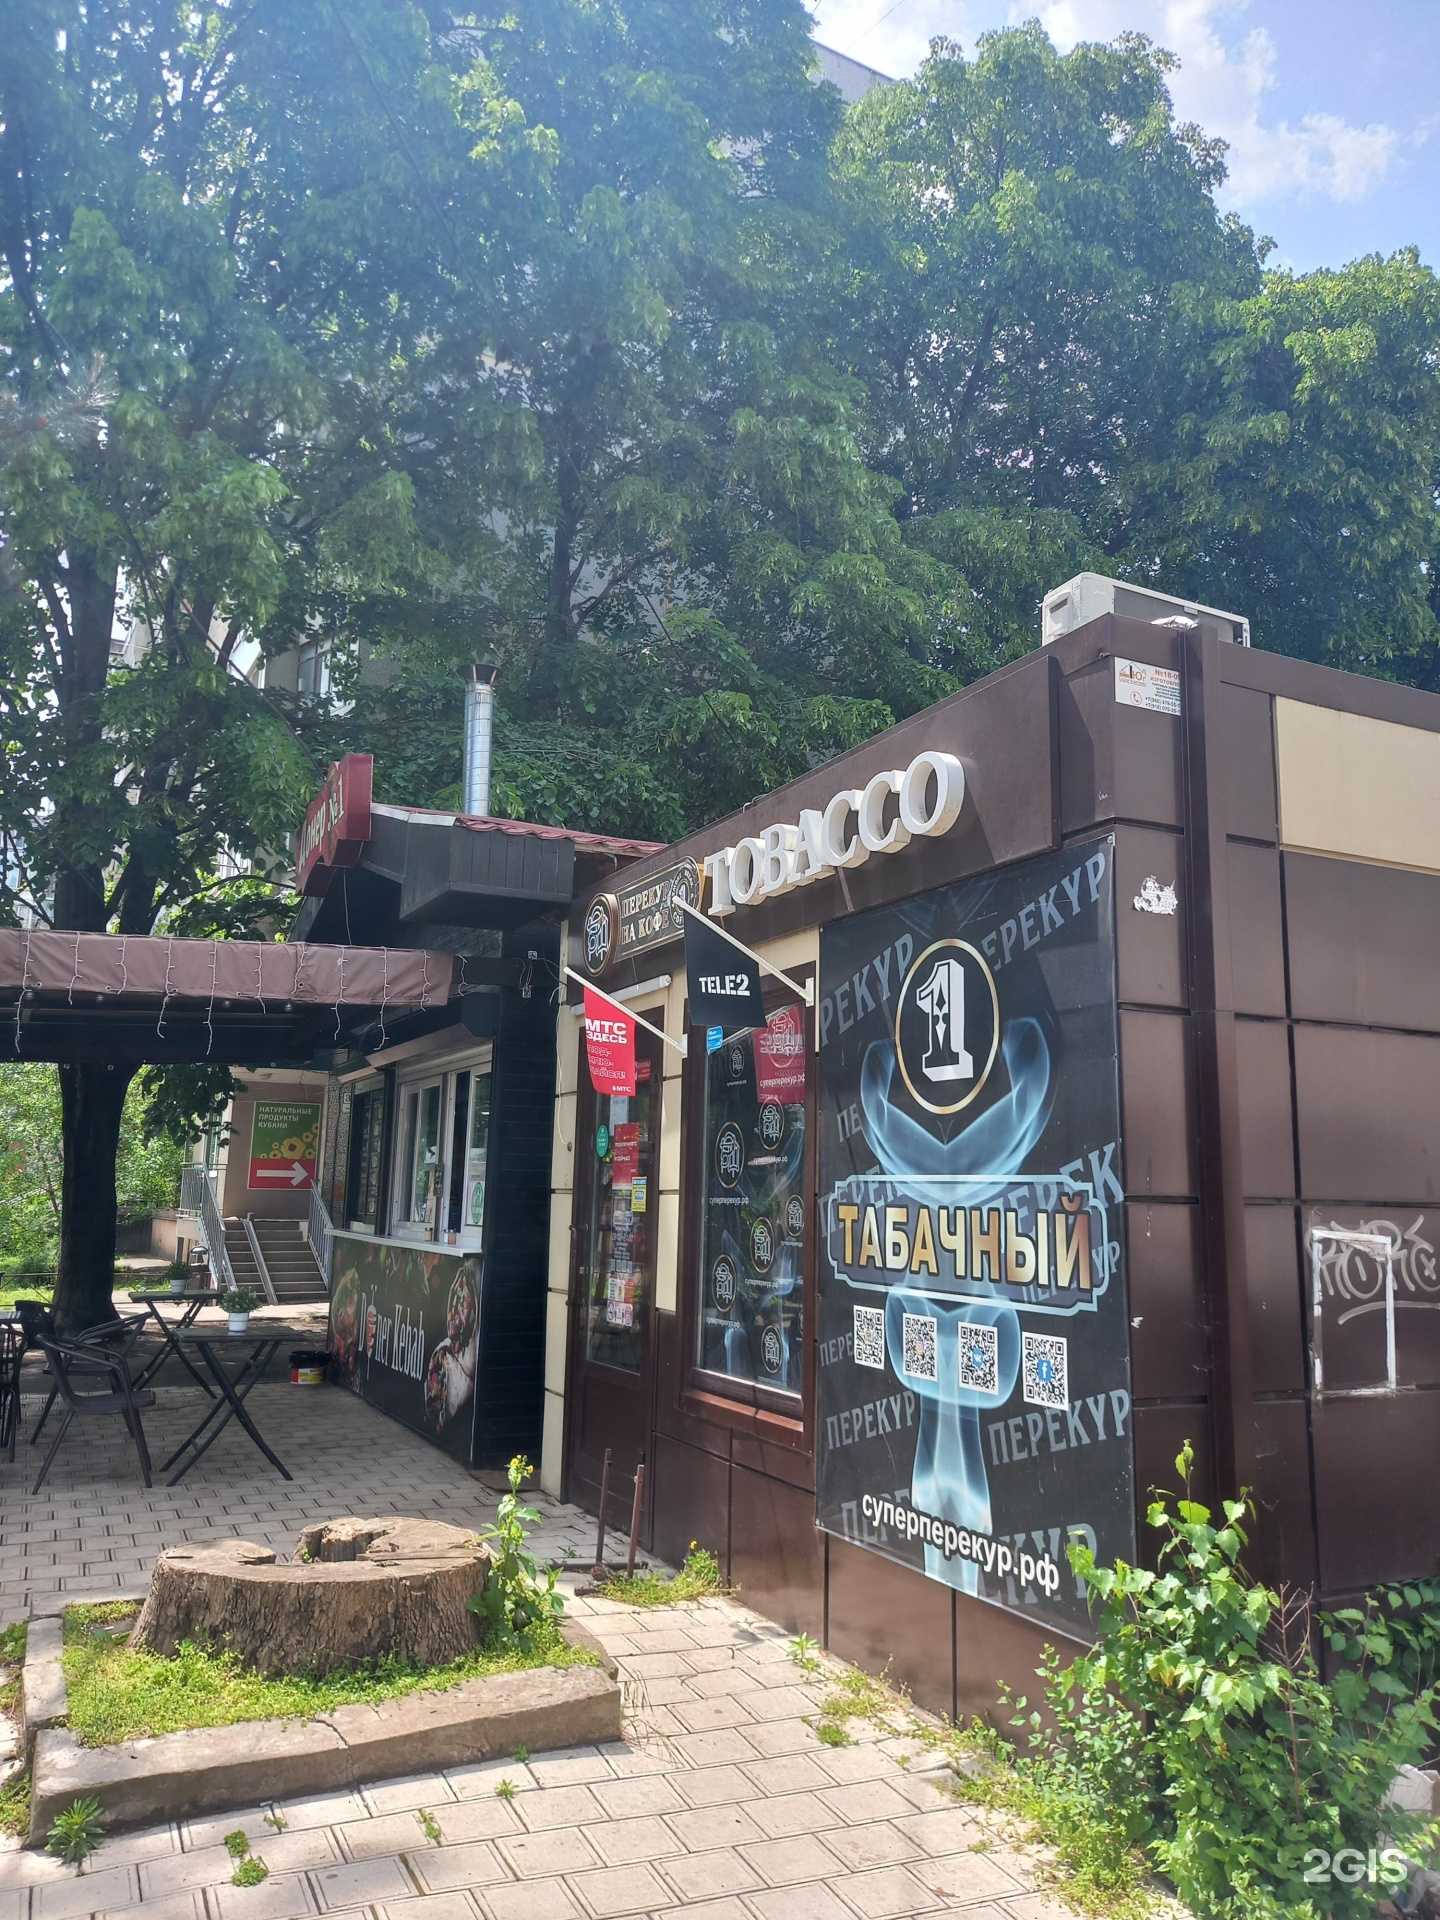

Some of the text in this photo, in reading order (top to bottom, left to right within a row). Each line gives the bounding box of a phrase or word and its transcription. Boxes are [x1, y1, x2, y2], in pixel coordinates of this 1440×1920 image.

[704, 751, 965, 916] TOBACCO
[622, 880, 670, 918] ПЕРЕКУР
[622, 923, 635, 944] НА
[699, 974, 750, 996] TELE2
[585, 1018, 626, 1035] МТС
[586, 1030, 628, 1044] ЗДЕСЬ
[917, 958, 973, 1082] 1
[258, 1113, 299, 1121] ПРОДУКТЫ
[258, 1121, 288, 1129] КУБАНИ
[259, 1106, 313, 1115] НАТУРАЛЬНЫЕ
[838, 1194, 1092, 1290] ТАБАЧНЫЙ
[392, 1303, 425, 1382] Kebab
[826, 1391, 915, 1450] ПЕРЕКУР
[987, 1388, 1131, 1466] ПЕРЕКУР
[862, 1494, 1059, 1596] суперперекур.рф
